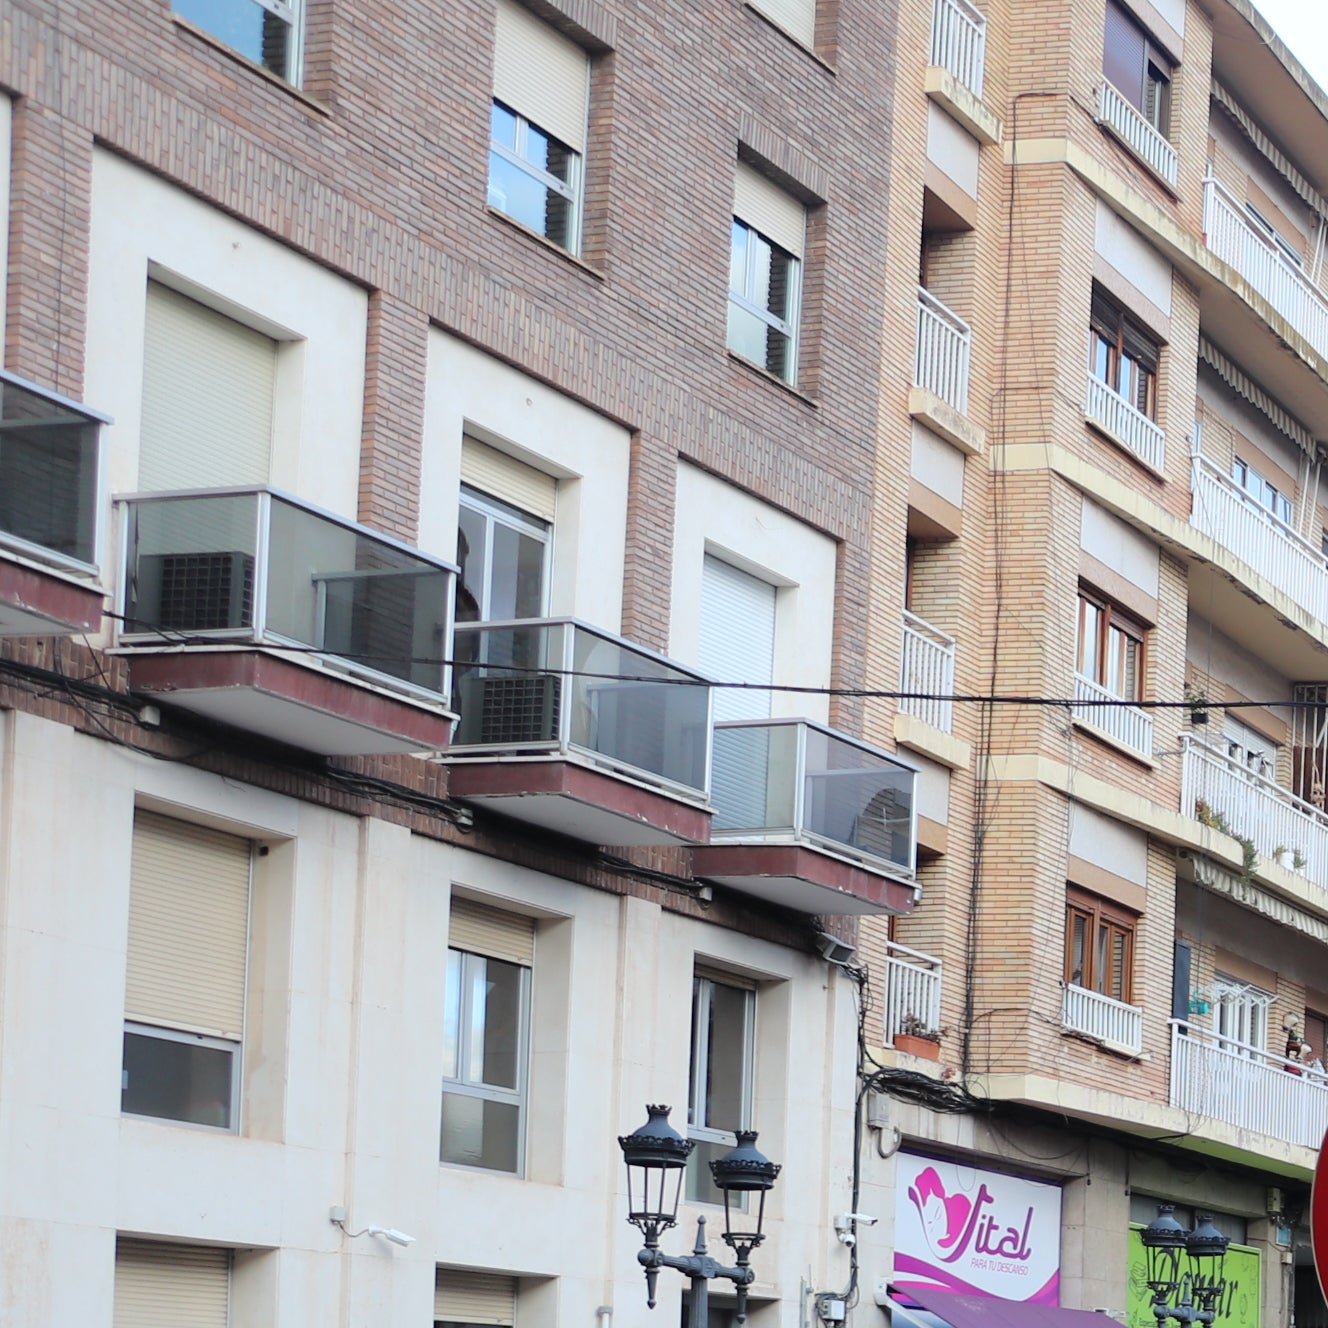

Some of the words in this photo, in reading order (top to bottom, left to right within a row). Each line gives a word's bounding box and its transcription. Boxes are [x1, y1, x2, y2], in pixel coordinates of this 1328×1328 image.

[908, 1183, 1032, 1263] Vital
[970, 1257, 988, 1270] PARA
[998, 1262, 1029, 1276] DESCANSO
